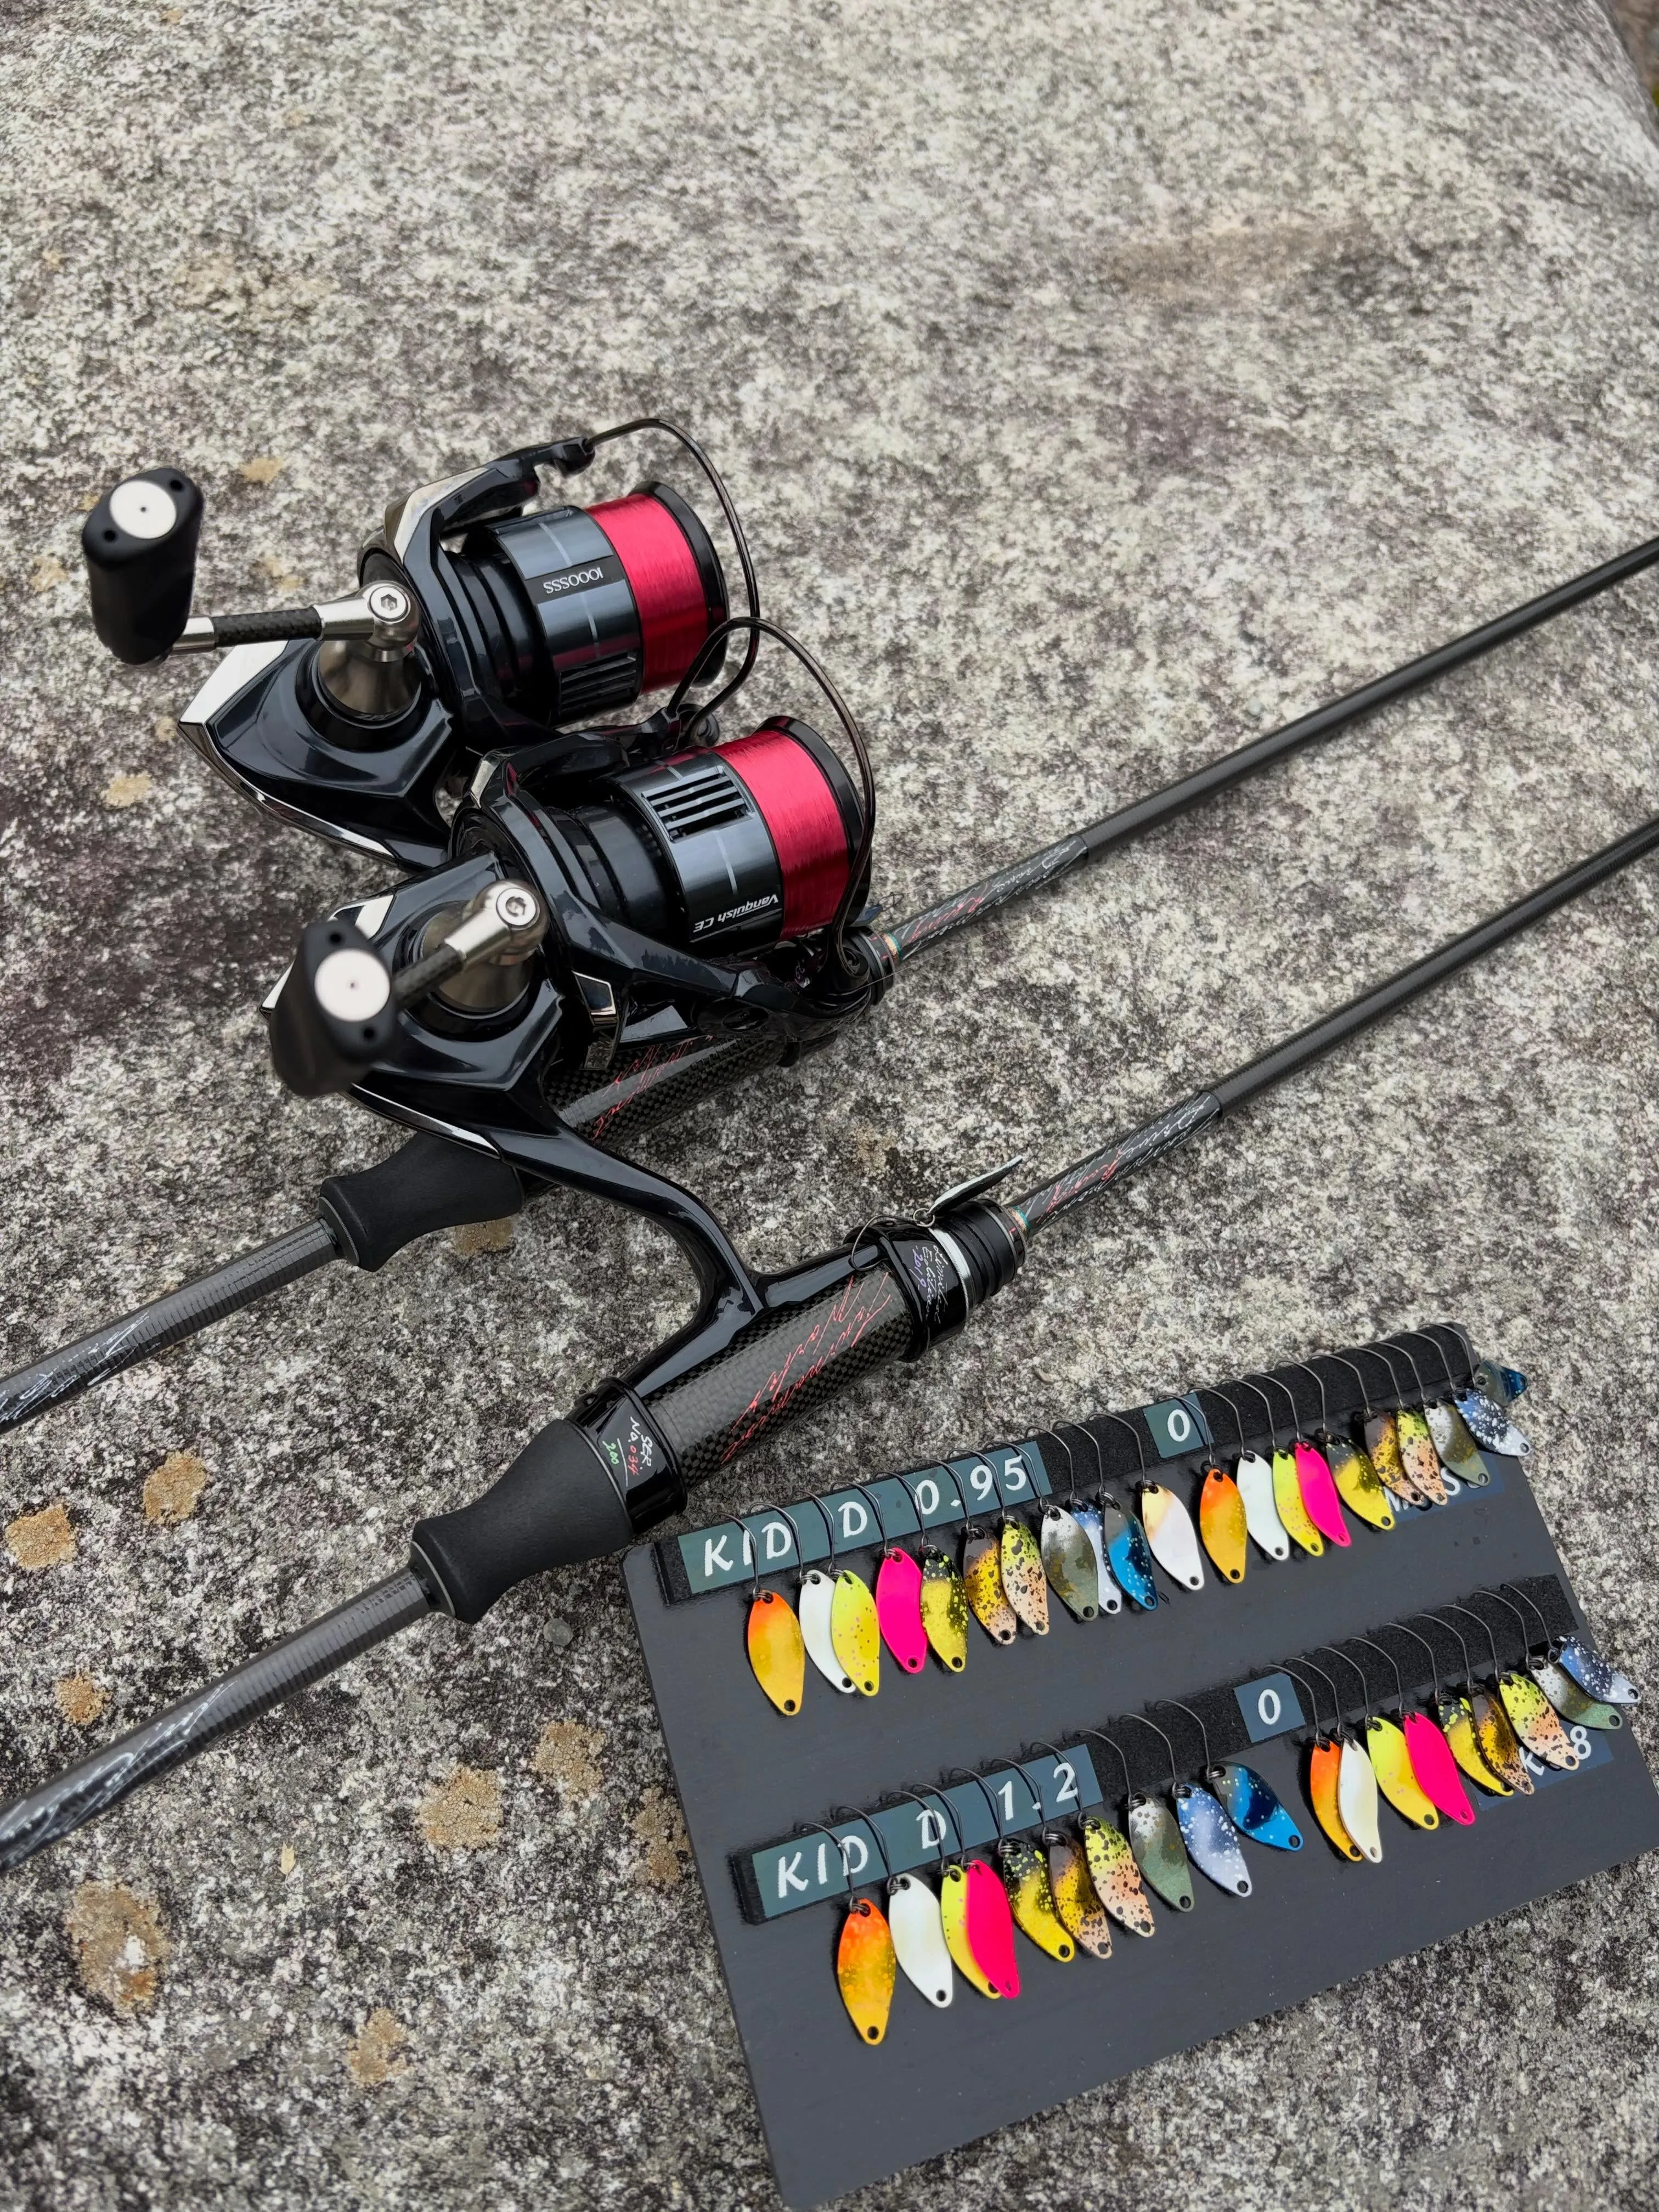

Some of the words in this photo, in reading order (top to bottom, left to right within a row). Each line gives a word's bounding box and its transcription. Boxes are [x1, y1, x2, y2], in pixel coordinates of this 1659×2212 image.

[543, 567, 603, 594] 1000SSS
[718, 894, 779, 922] Vanquish
[693, 917, 714, 933] CE
[602, 1441, 619, 1464] 200
[704, 1522, 791, 1577] KID
[838, 1502, 867, 1538] D
[913, 1455, 1026, 1515] 0.95
[778, 1836, 868, 1898] KID
[916, 1810, 946, 1849] D
[998, 1763, 1077, 1820] 1.2
